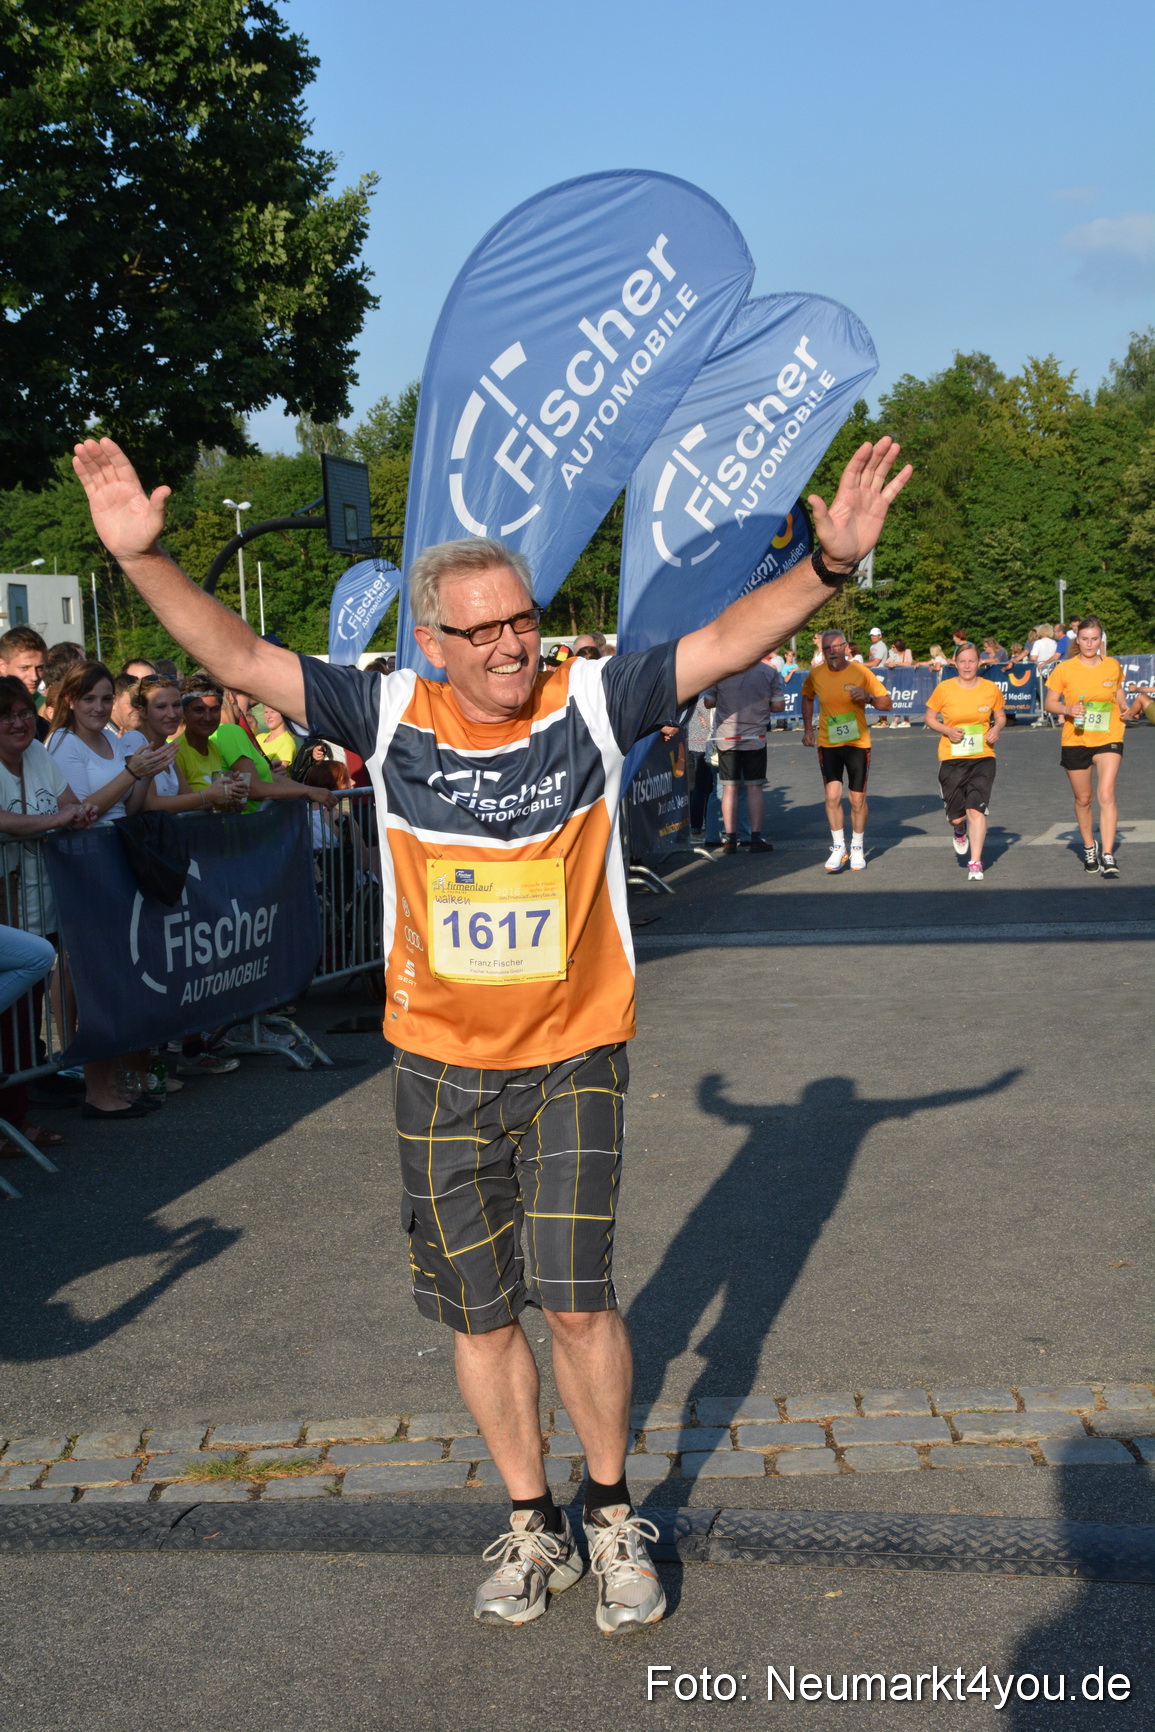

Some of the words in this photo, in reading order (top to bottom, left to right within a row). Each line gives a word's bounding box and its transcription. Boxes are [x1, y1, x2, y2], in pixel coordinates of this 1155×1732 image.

[493, 232, 678, 495] Fischer
[559, 282, 699, 491] AUTOMOBILE
[683, 334, 820, 534] Fischer
[733, 368, 837, 530] AUTOMOBILE
[346, 571, 386, 630] Fischer
[361, 581, 392, 629] AUTOMOBILE
[1008, 692, 1032, 701] Medien
[836, 725, 850, 736] 53
[962, 737, 975, 748] 74
[451, 770, 567, 811] Fischer
[435, 894, 471, 905] walken
[447, 881, 494, 892] firmenlauf
[163, 898, 278, 973] Fischer
[443, 909, 551, 950] 1617
[180, 955, 270, 1006] AUTOMOBILE
[397, 974, 417, 987] SEAT
[469, 958, 492, 967] Franz
[493, 959, 524, 967] Fischer
